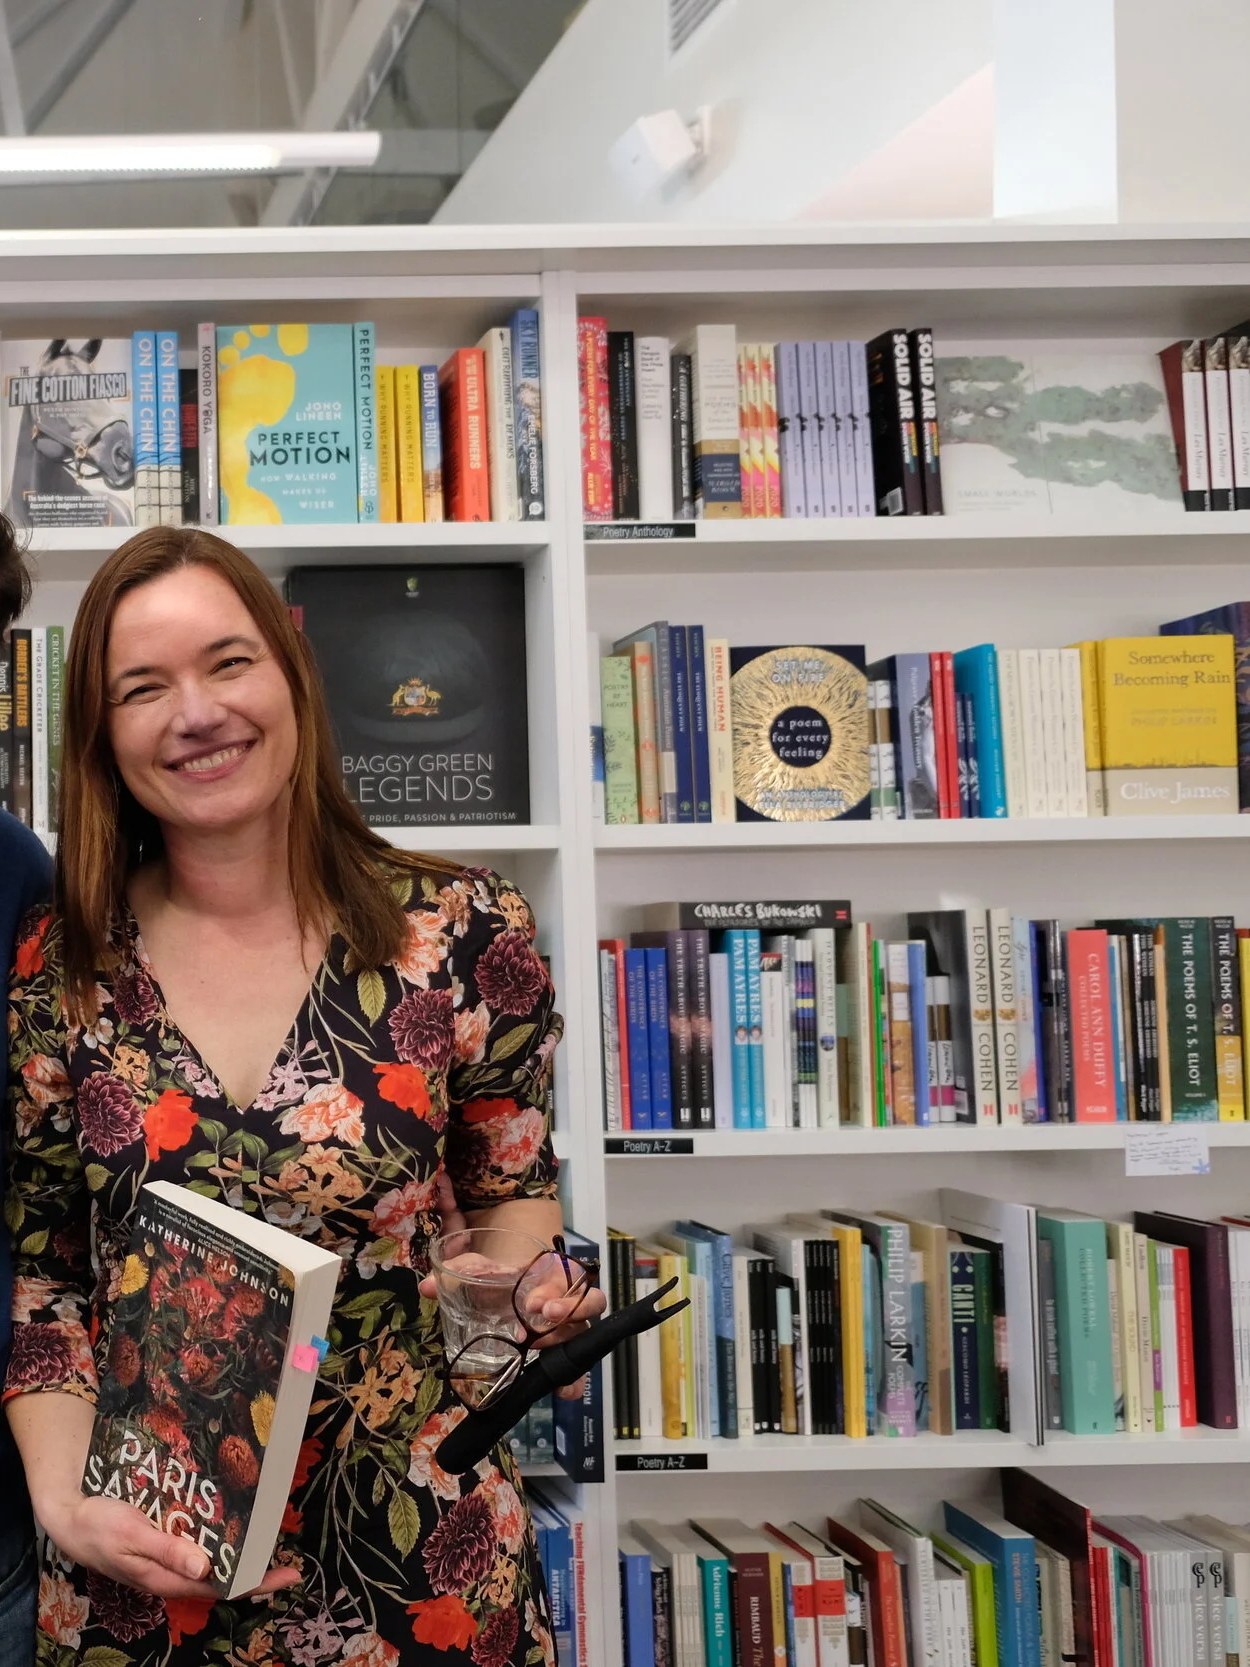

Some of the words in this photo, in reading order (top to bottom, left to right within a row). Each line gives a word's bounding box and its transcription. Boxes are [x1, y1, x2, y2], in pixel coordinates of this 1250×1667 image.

[138, 338, 152, 366] ON
[893, 334, 911, 384] SOLID
[20, 367, 30, 376] THE
[11, 378, 38, 405] FINE
[42, 376, 88, 402] COTTON
[90, 374, 126, 398] FIASCO
[140, 372, 153, 402] THE
[422, 373, 436, 407] BORN
[426, 410, 436, 419] TO
[898, 388, 914, 419] AIR
[140, 408, 154, 452] CHIN
[258, 432, 340, 445] PERFECT
[425, 422, 438, 448] RUN
[250, 446, 350, 465] MOTION
[603, 527, 629, 538] Poetry
[632, 526, 673, 538] Anthology
[16, 639, 28, 681] BORDER'S
[1129, 651, 1215, 666] Somewhere
[1112, 672, 1189, 688] Becoming
[1193, 671, 1231, 684] Rain
[16, 684, 28, 727] BATTLERS
[778, 720, 784, 728] a
[790, 719, 823, 729] poem
[772, 732, 792, 743] for
[795, 733, 829, 745] every
[342, 755, 414, 773] BAGGY
[419, 753, 492, 772] GREEN
[779, 747, 823, 759] feeling
[342, 775, 493, 802] LEGENDS
[1120, 783, 1164, 799] Clive
[1170, 782, 1230, 803] James
[369, 814, 401, 823] PRIDE,
[404, 813, 446, 822] PASSION
[449, 813, 456, 821] &
[459, 812, 516, 821] PATRIOTISM
[694, 904, 752, 918] CHARLES
[756, 904, 822, 918] BUKOWSKI
[734, 938, 744, 970] PAM
[1182, 933, 1193, 956] THE
[972, 926, 988, 1004] LEONARD
[1088, 953, 1102, 1000] CAROL
[1183, 960, 1195, 999] POEMS
[735, 974, 746, 1023] AYRES
[1186, 1003, 1197, 1020] OF
[1092, 1006, 1103, 1036] ANN
[1186, 1024, 1197, 1034] T.
[1187, 1038, 1197, 1048] S.
[978, 1033, 992, 1092] COHEN
[1093, 1042, 1107, 1088] DUFFY
[1188, 1053, 1200, 1086] ELIOT
[624, 1141, 650, 1152] Poetry
[652, 1140, 671, 1151] A-Z
[138, 1215, 213, 1263] KATHERINE
[220, 1260, 289, 1307] JOHNSON
[198, 1238, 212, 1249] ALICE
[212, 1244, 230, 1258] NELSON
[887, 1226, 904, 1285] PHILIP
[890, 1291, 907, 1362] LARKIN
[118, 1429, 217, 1519] PARIS
[637, 1456, 666, 1469] Poetry
[667, 1456, 686, 1468] A-Z
[551, 1569, 560, 1626] ANTARCTICA
[712, 1566, 722, 1609] Adrienne
[715, 1612, 724, 1637] Rich
[750, 1596, 760, 1644] RIMBAUD
